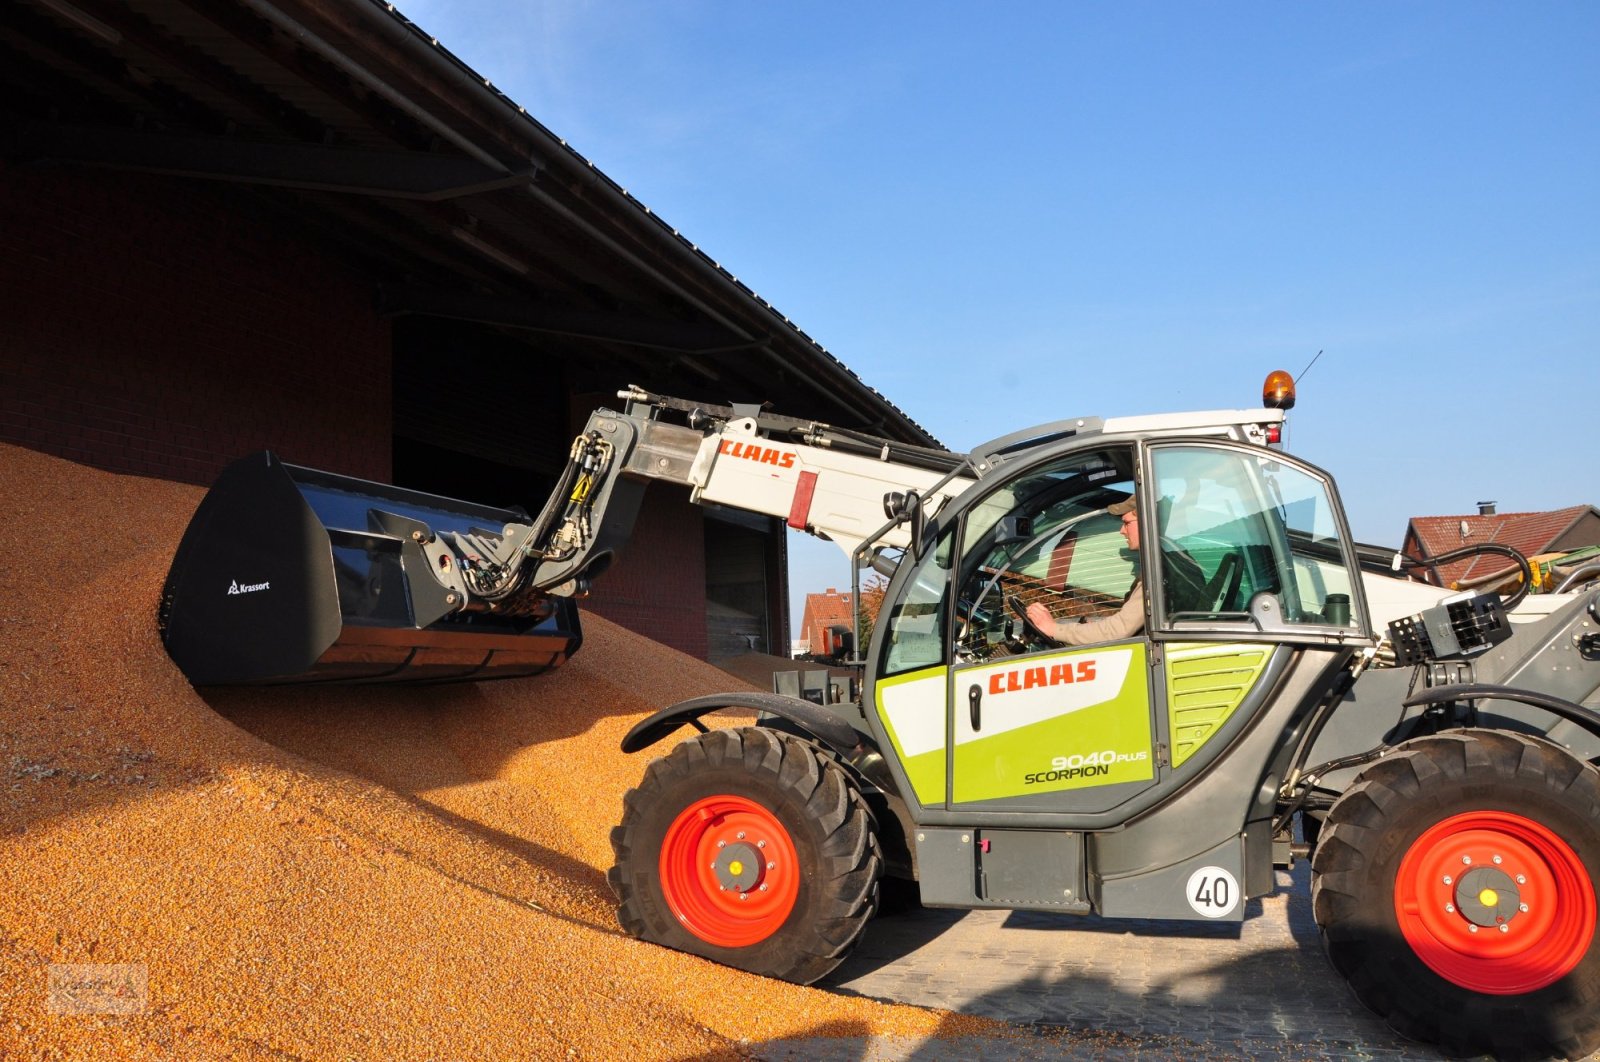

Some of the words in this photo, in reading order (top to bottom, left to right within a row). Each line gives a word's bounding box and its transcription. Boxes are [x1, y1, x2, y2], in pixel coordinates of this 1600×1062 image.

[719, 440, 796, 468] CLAAS
[240, 581, 270, 593] Krassort
[988, 660, 1096, 695] CLAAS
[1051, 750, 1117, 771] 9040
[1117, 751, 1147, 762] PLUS
[1024, 764, 1109, 784] SCORPION
[1195, 876, 1229, 908] 40
